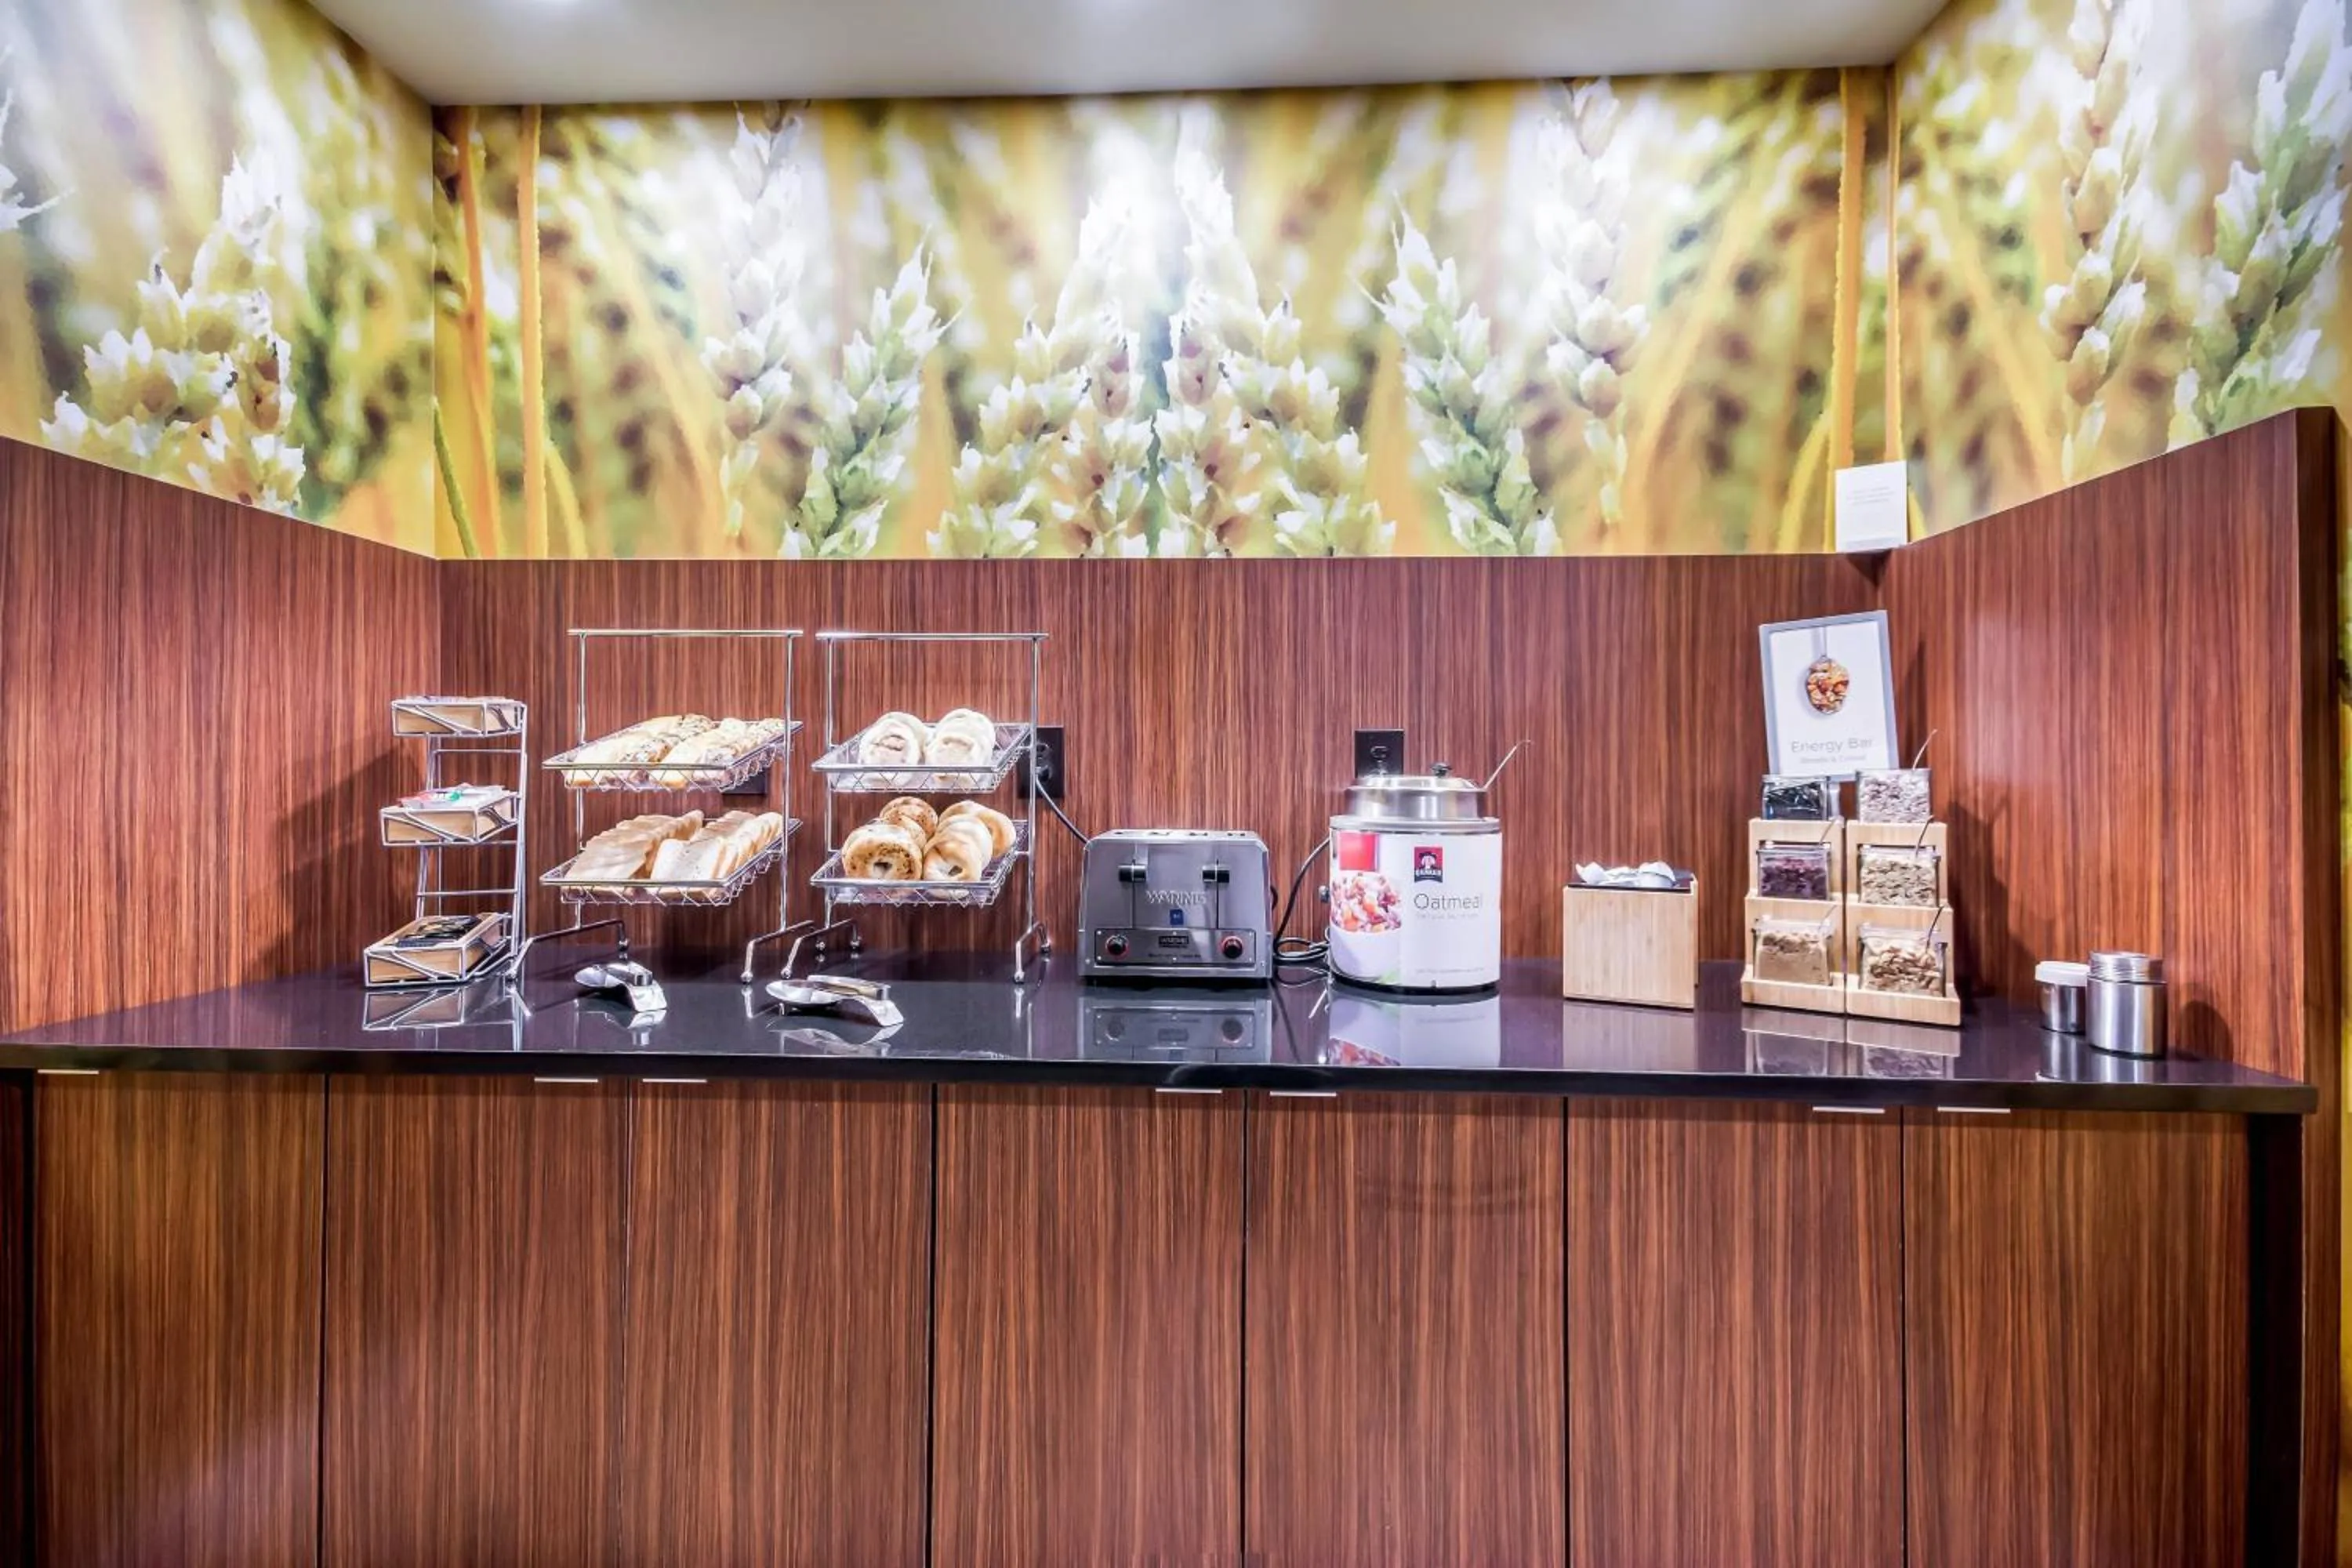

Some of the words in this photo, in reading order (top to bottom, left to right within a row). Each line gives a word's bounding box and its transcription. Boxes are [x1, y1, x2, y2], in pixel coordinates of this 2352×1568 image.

[1791, 741, 1843, 753] Energy
[1849, 738, 1872, 750] Bar
[1145, 890, 1207, 905] WARING
[1414, 892, 1483, 910] Oatmeal
